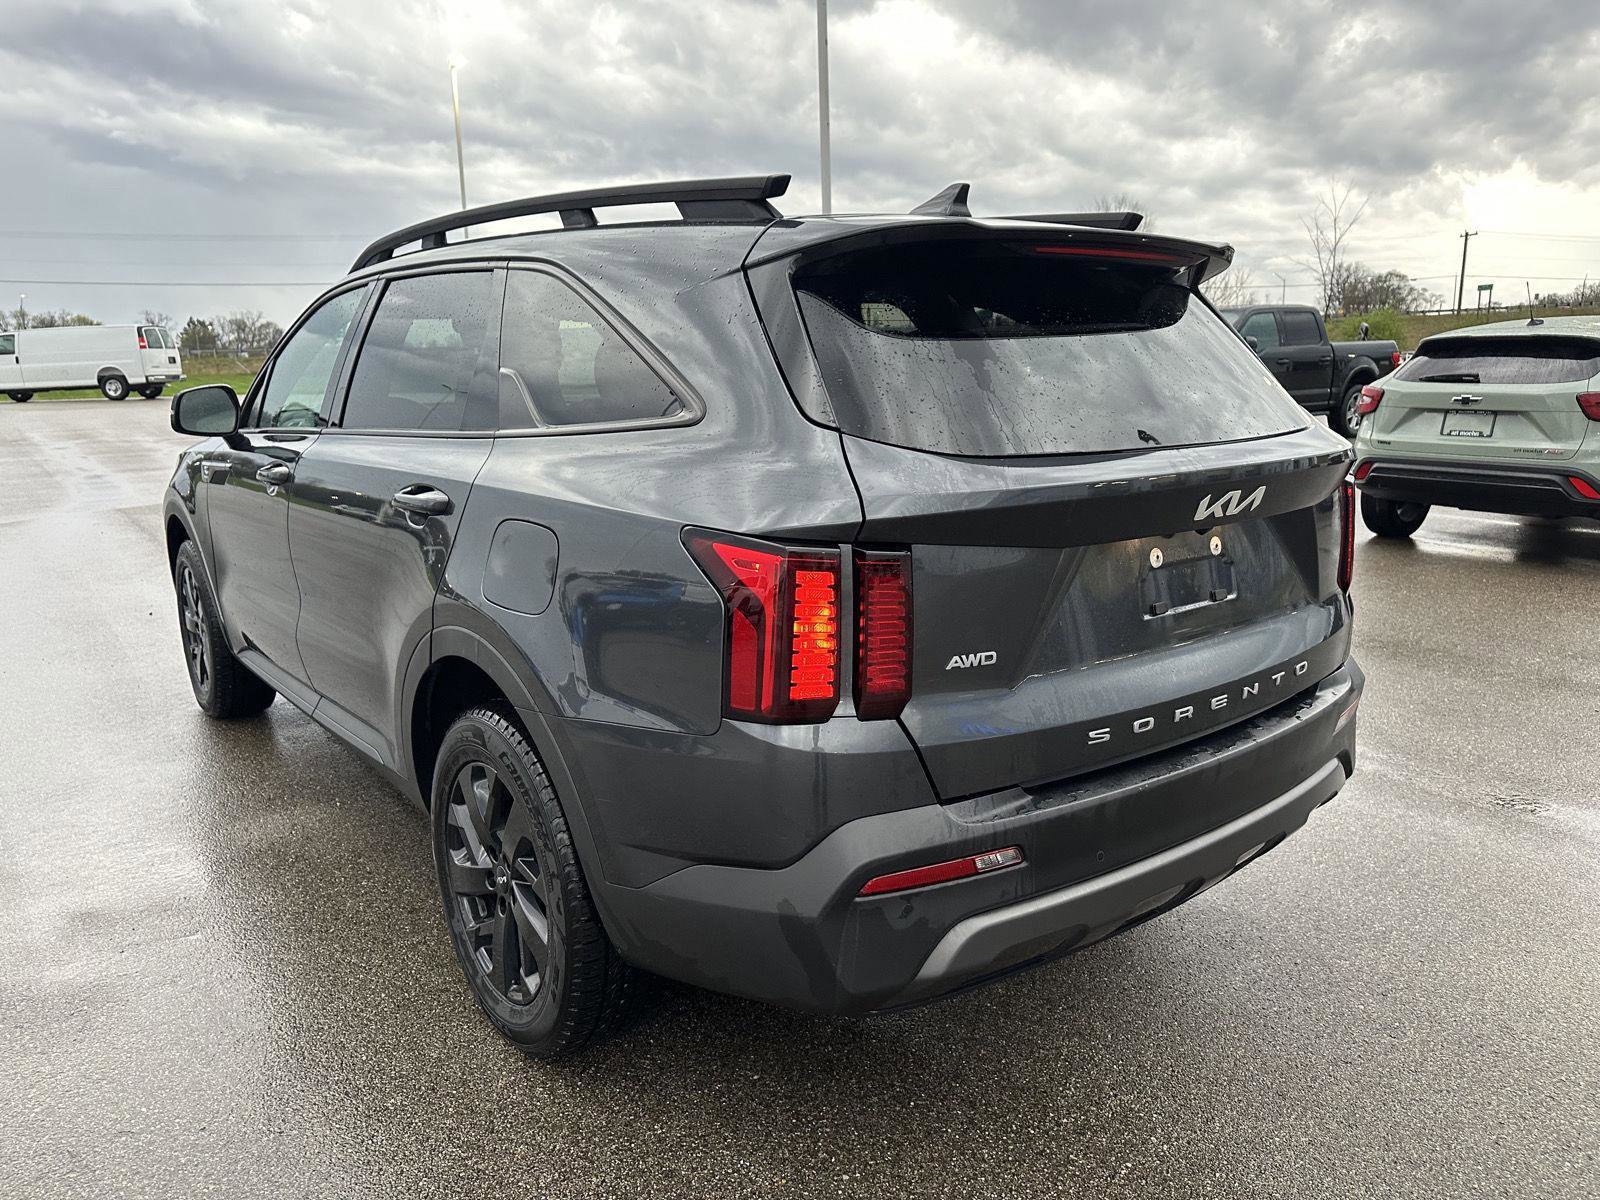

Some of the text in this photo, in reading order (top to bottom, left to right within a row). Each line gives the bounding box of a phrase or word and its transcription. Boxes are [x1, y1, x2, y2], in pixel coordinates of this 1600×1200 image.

[1193, 485, 1267, 521] KIA
[945, 651, 997, 670] AWD
[1088, 660, 1308, 745] SORENTO
